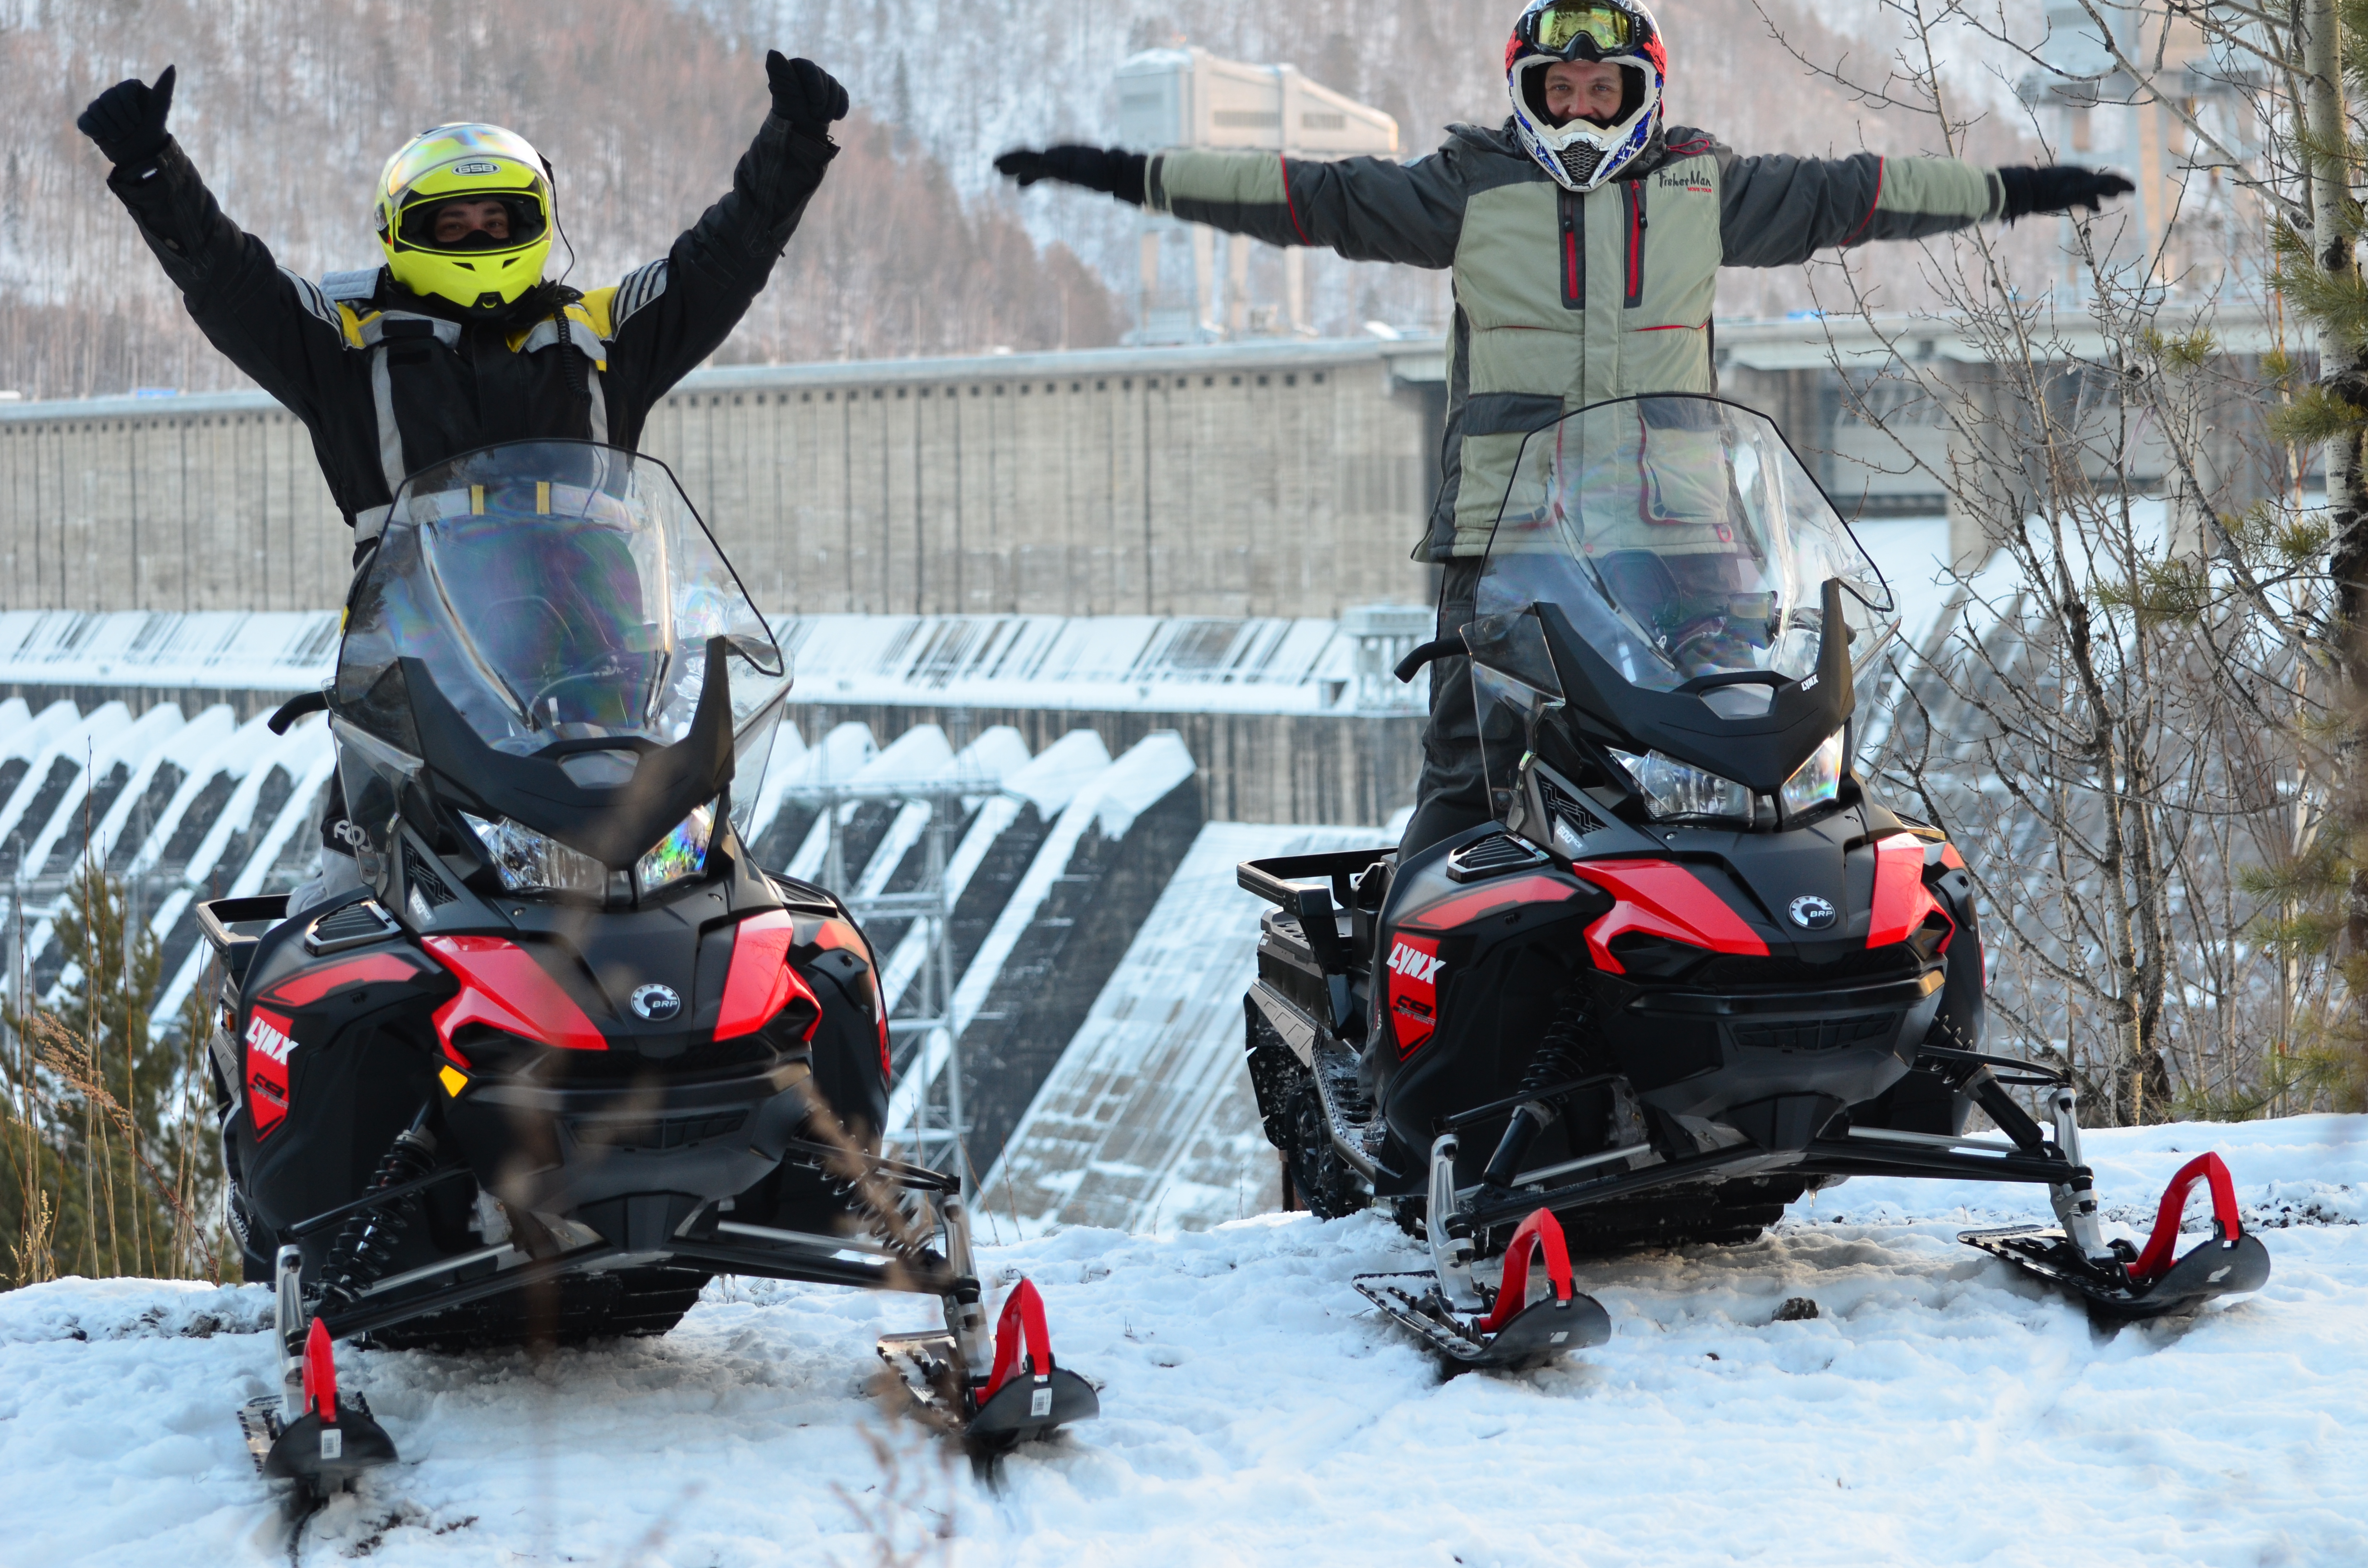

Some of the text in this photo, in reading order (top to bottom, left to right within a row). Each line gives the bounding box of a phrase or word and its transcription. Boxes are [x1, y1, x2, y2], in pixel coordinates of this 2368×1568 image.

[458, 164, 494, 173] GSB
[1801, 674, 1819, 691] LYNX
[1386, 942, 1446, 984] LYNX
[246, 1016, 300, 1066] LYNX
